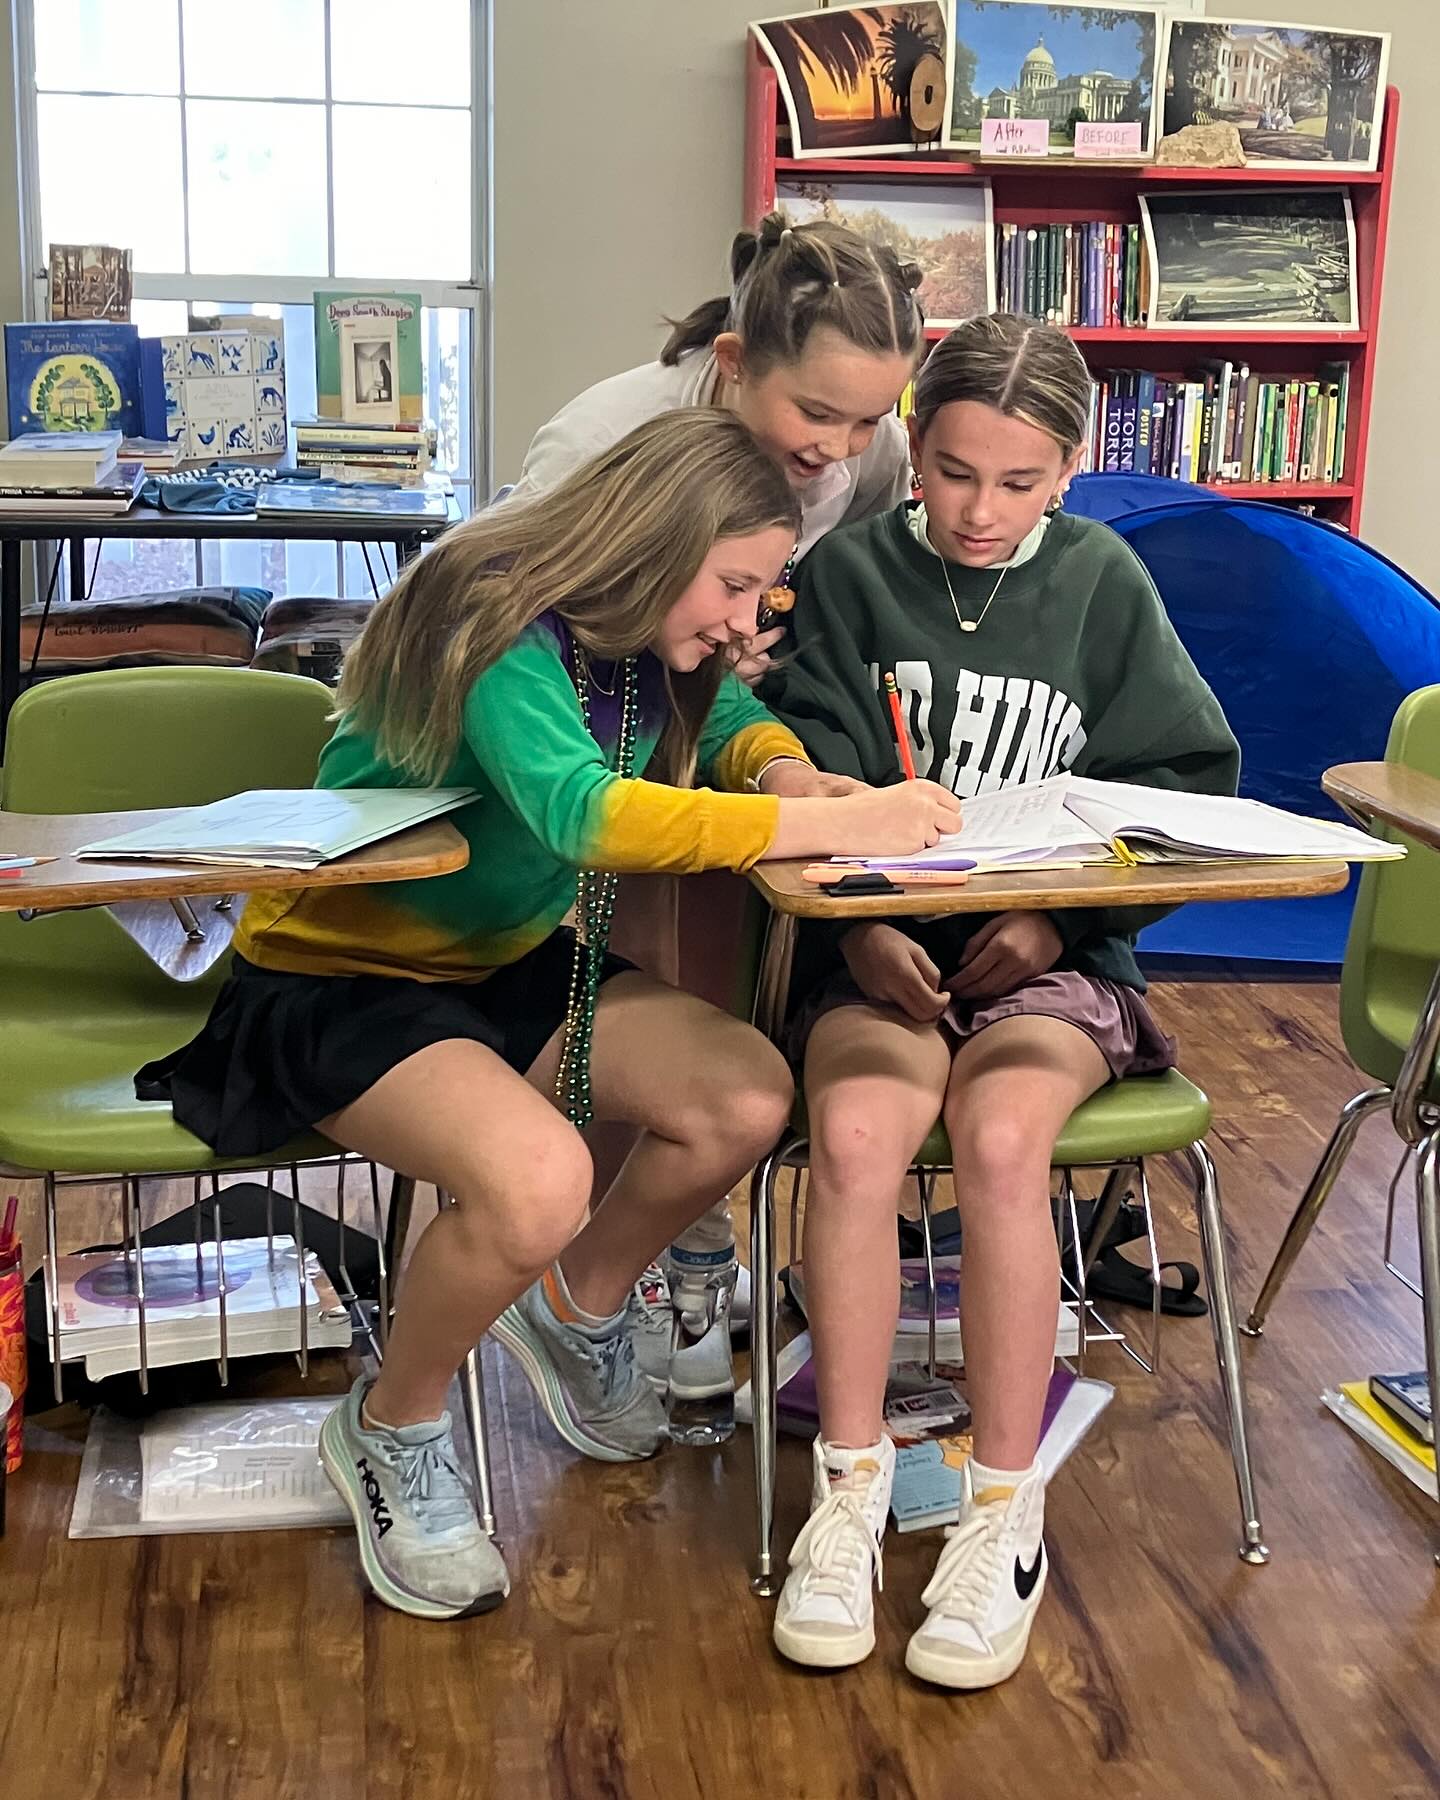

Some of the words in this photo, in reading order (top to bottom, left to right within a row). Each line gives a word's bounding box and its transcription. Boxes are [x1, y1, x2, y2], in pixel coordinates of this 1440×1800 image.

[994, 122, 1024, 142] After
[1081, 128, 1131, 144] BEFORE
[329, 304, 351, 319] Deep
[352, 304, 379, 317] South
[380, 304, 413, 320] Staples
[21, 340, 40, 353] The
[45, 340, 91, 353] Lantern
[1106, 408, 1121, 466] TORN
[1120, 408, 1135, 466] TORN
[1140, 408, 1151, 446] POSTED
[357, 1458, 394, 1539] HOKA
